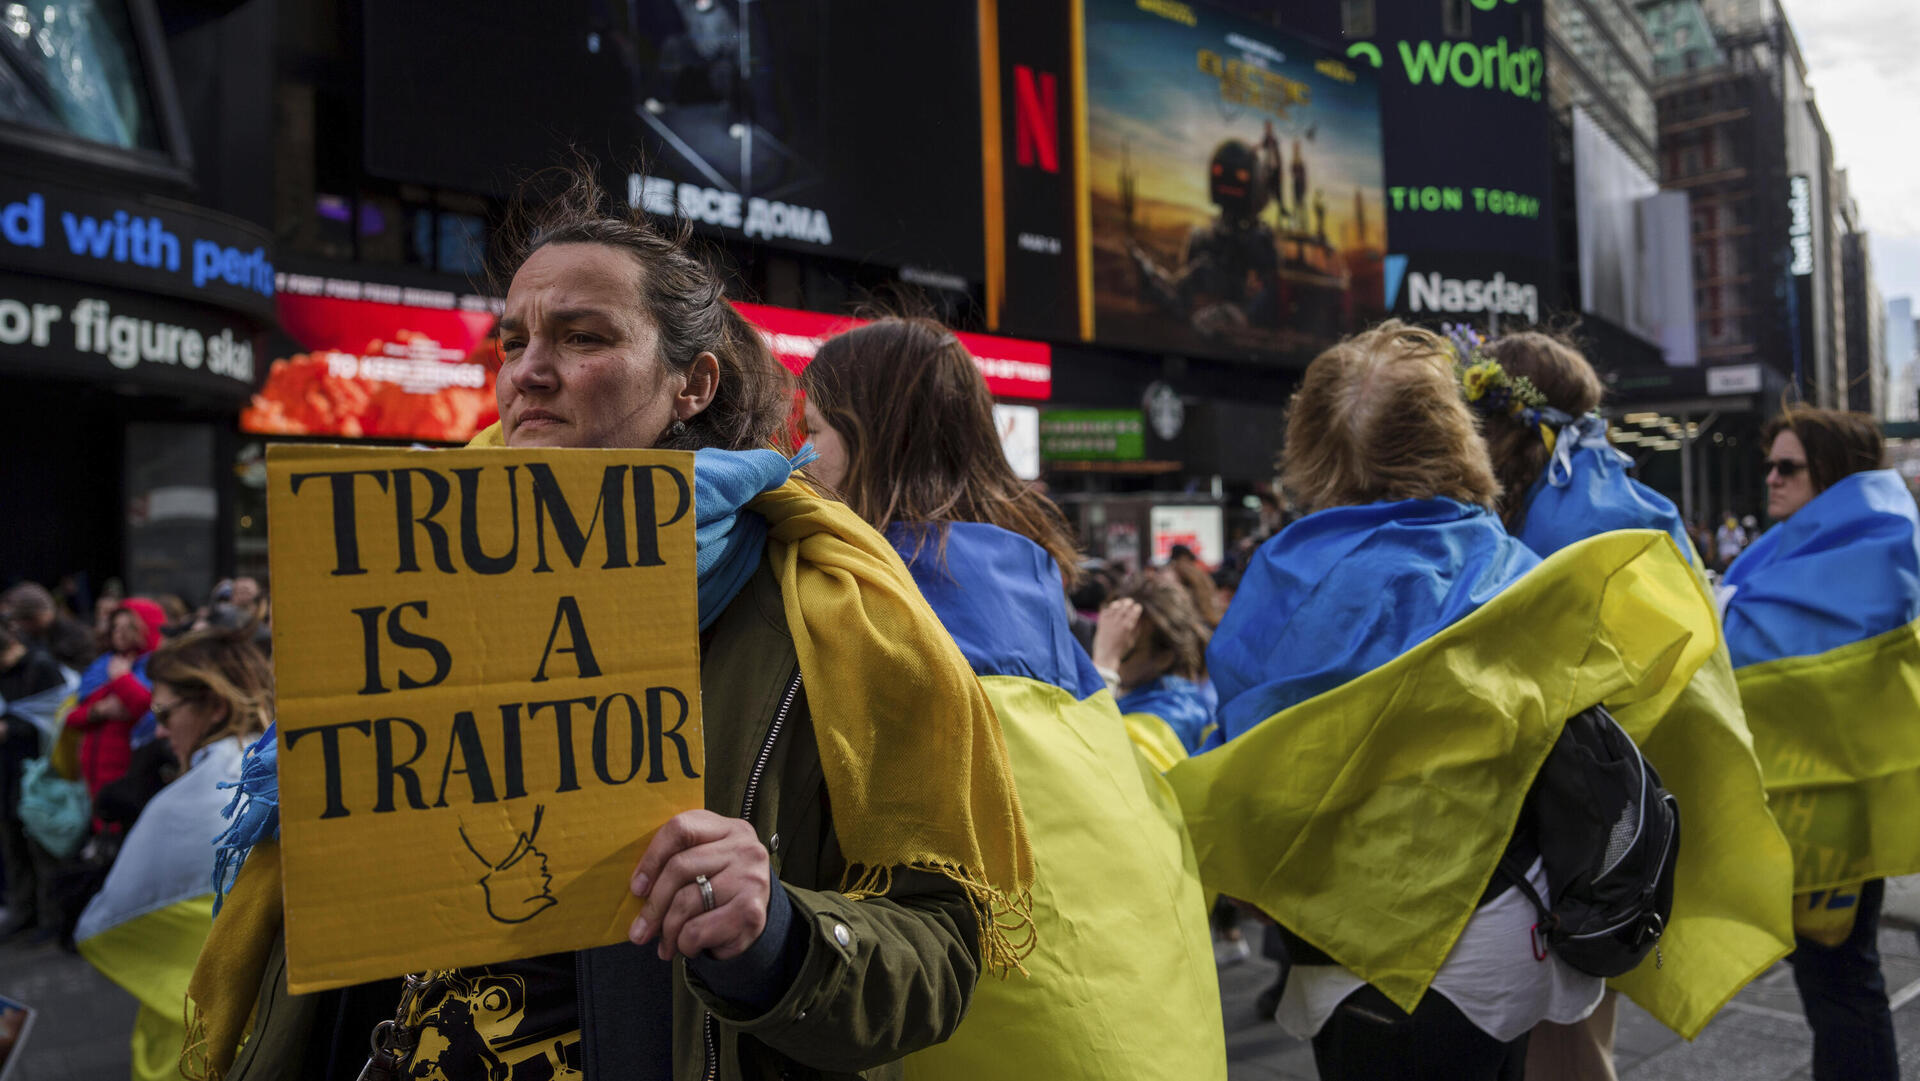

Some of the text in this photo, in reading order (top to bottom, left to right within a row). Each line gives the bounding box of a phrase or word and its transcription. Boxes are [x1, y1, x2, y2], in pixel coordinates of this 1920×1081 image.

[1398, 37, 1543, 100] world?
[1013, 64, 1059, 173] N
[0, 193, 45, 247] d
[61, 210, 181, 271] with
[677, 184, 742, 228] ВСЕ
[743, 197, 832, 244] ДОМА
[1389, 186, 1463, 211] TION
[71, 299, 204, 369] figure
[1408, 272, 1538, 324] Nasdaq
[290, 463, 691, 576] TRUMP
[351, 596, 602, 695] IS A
[284, 686, 701, 819] TRAITOR
